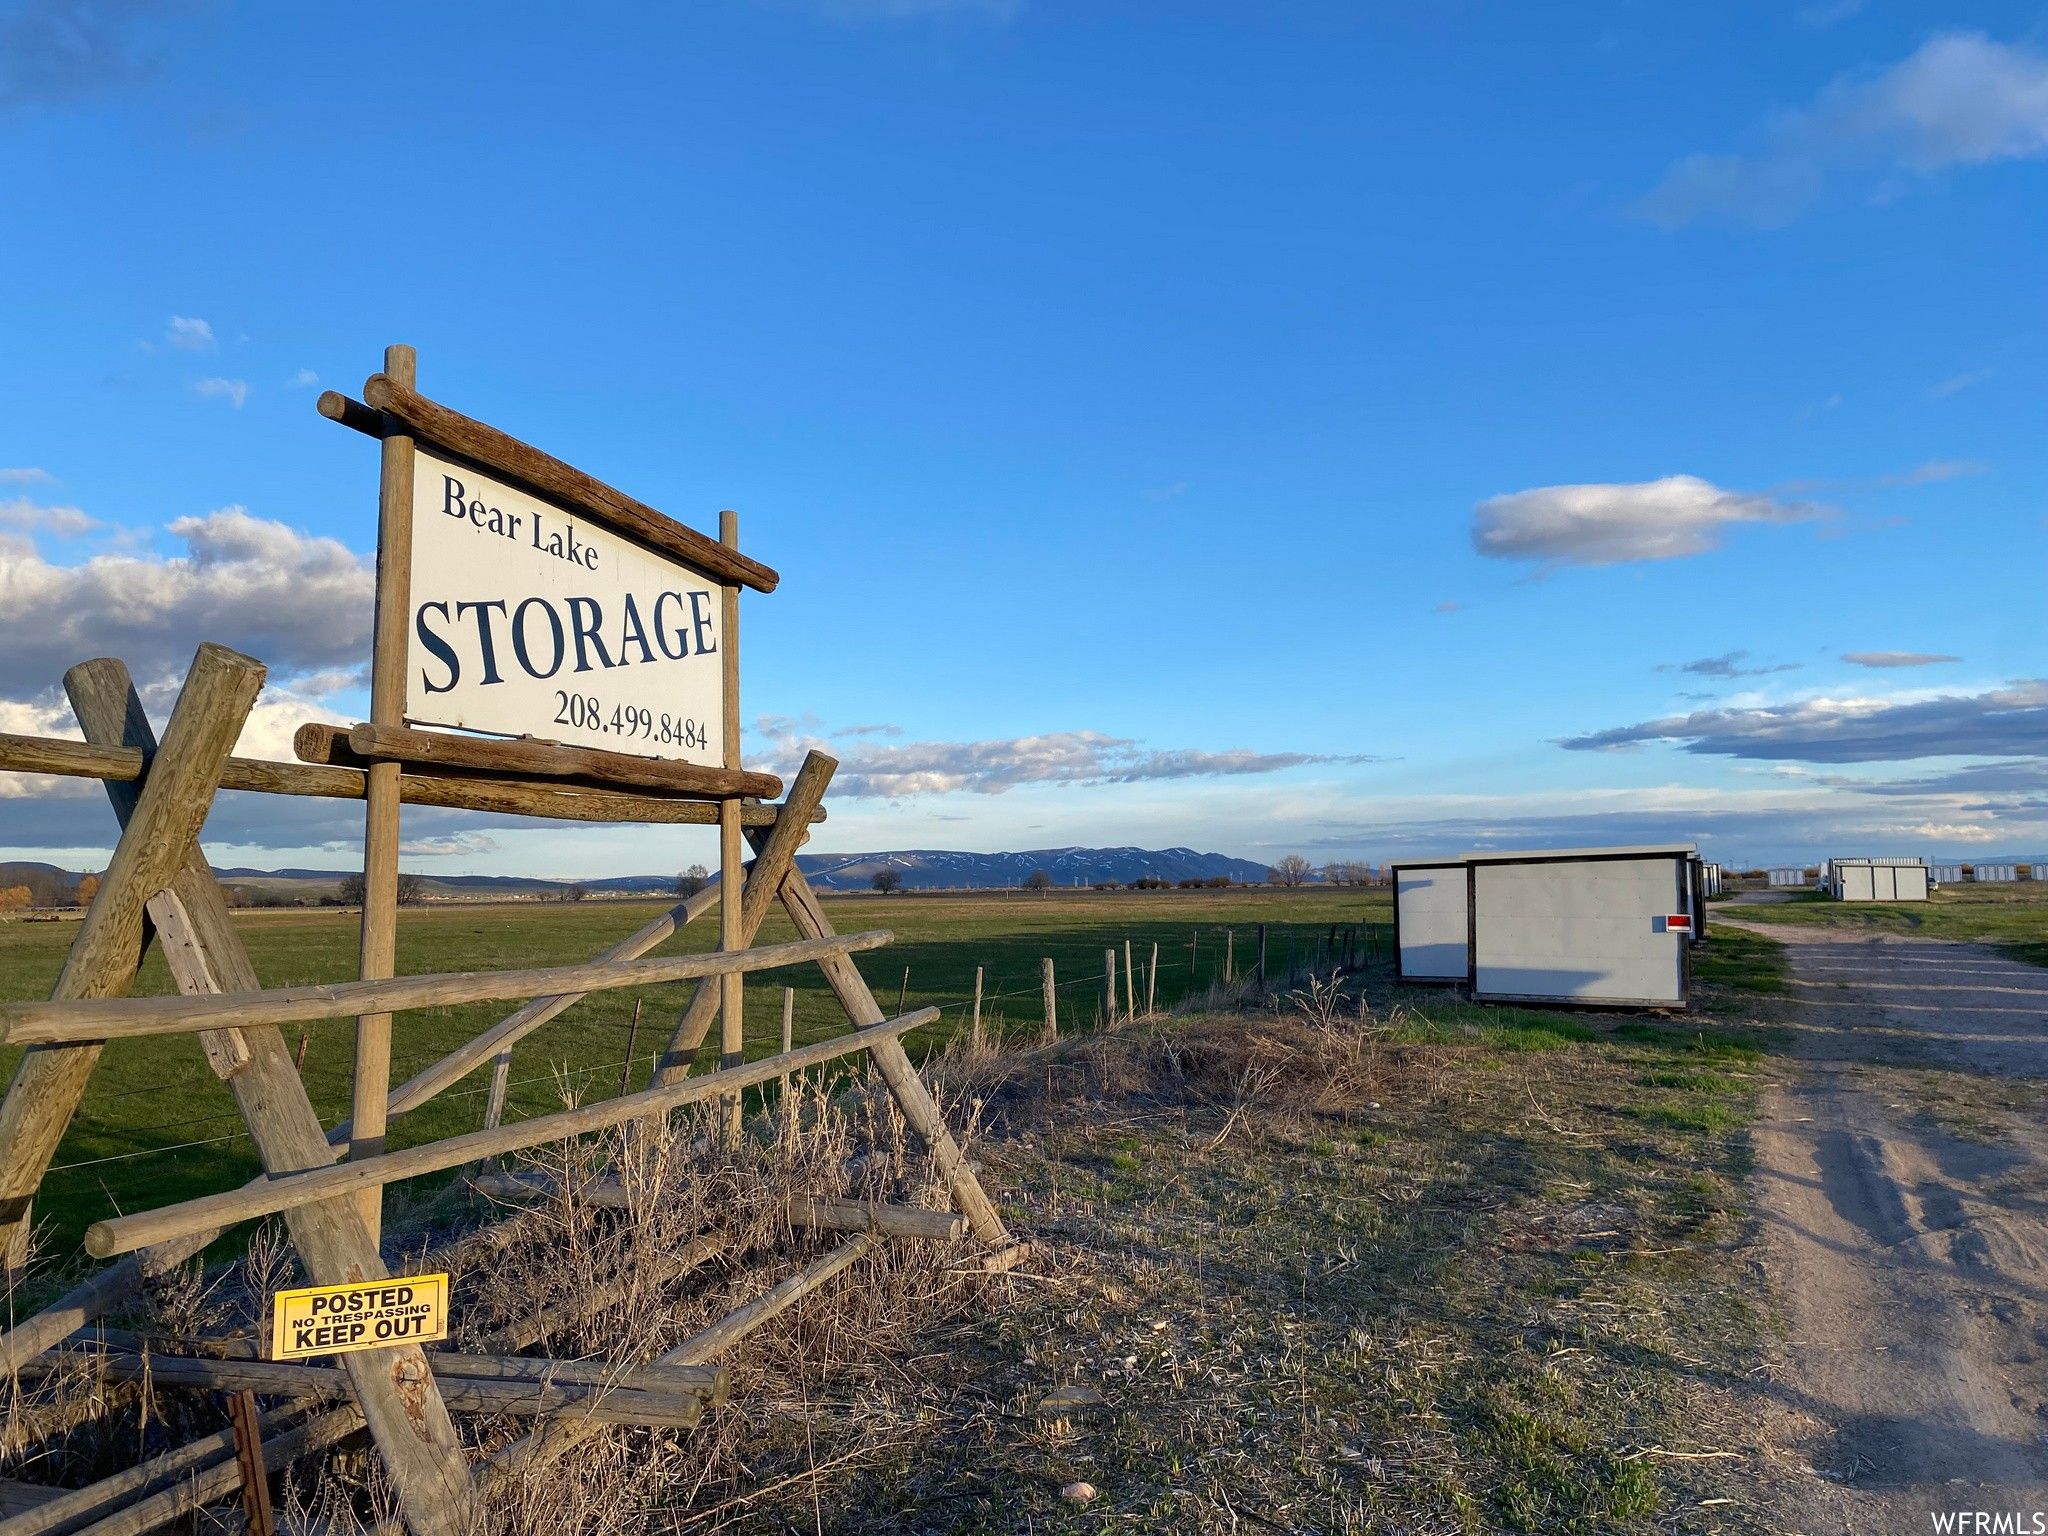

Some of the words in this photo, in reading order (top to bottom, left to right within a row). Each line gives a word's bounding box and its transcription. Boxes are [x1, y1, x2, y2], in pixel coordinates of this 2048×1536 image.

[442, 474, 521, 540] Bear
[531, 511, 599, 571] Lake
[416, 590, 717, 695] STORAGE
[553, 689, 708, 750] 208.499.8484
[293, 1318, 315, 1328] NO
[321, 1304, 431, 1325] TRESPASSING
[312, 1287, 413, 1315] POSTED
[296, 1323, 365, 1349] KEEP
[375, 1315, 426, 1339] OUT
